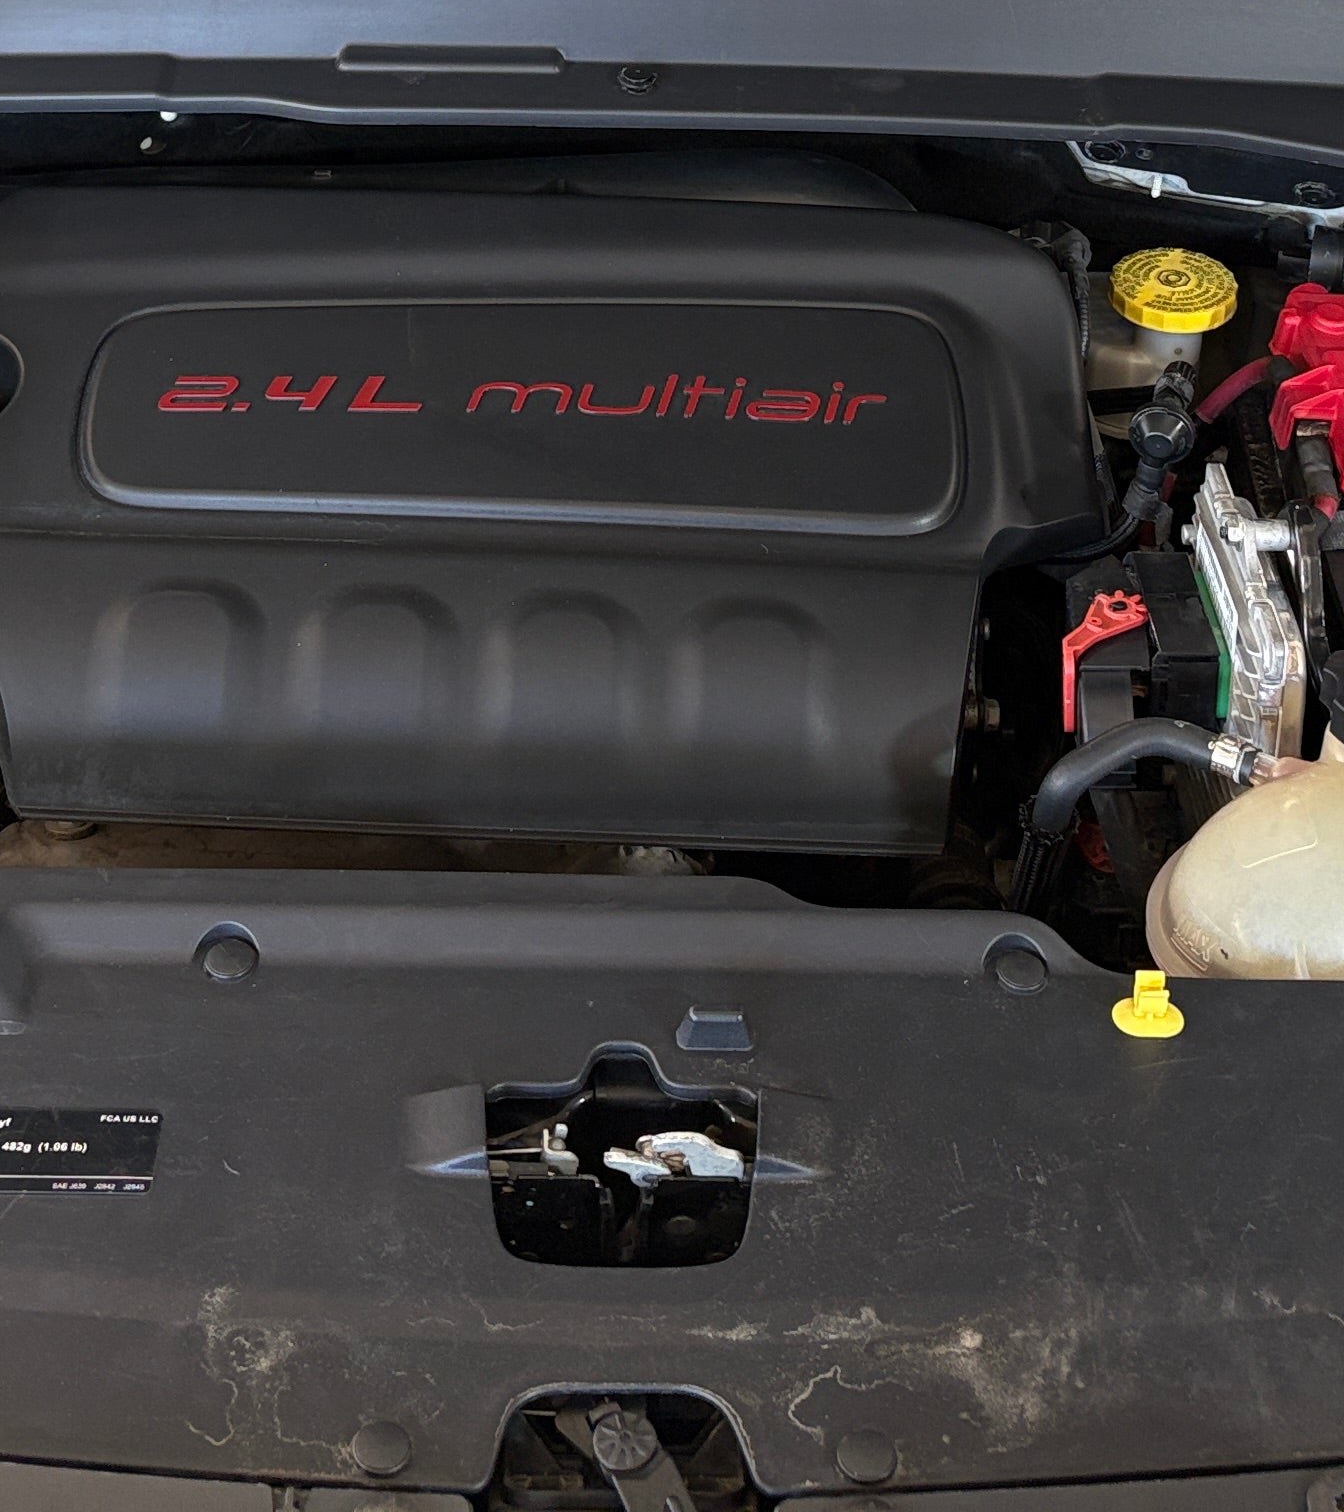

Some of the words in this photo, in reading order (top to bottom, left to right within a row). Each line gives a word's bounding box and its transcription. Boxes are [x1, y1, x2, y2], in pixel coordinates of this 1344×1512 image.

[465, 373, 888, 426] multiair
[100, 1114, 121, 1123] FCA
[123, 1114, 137, 1123] US
[138, 1115, 159, 1124] LLC
[1, 1141, 32, 1154] 482g
[37, 1141, 68, 1154] (1.06
